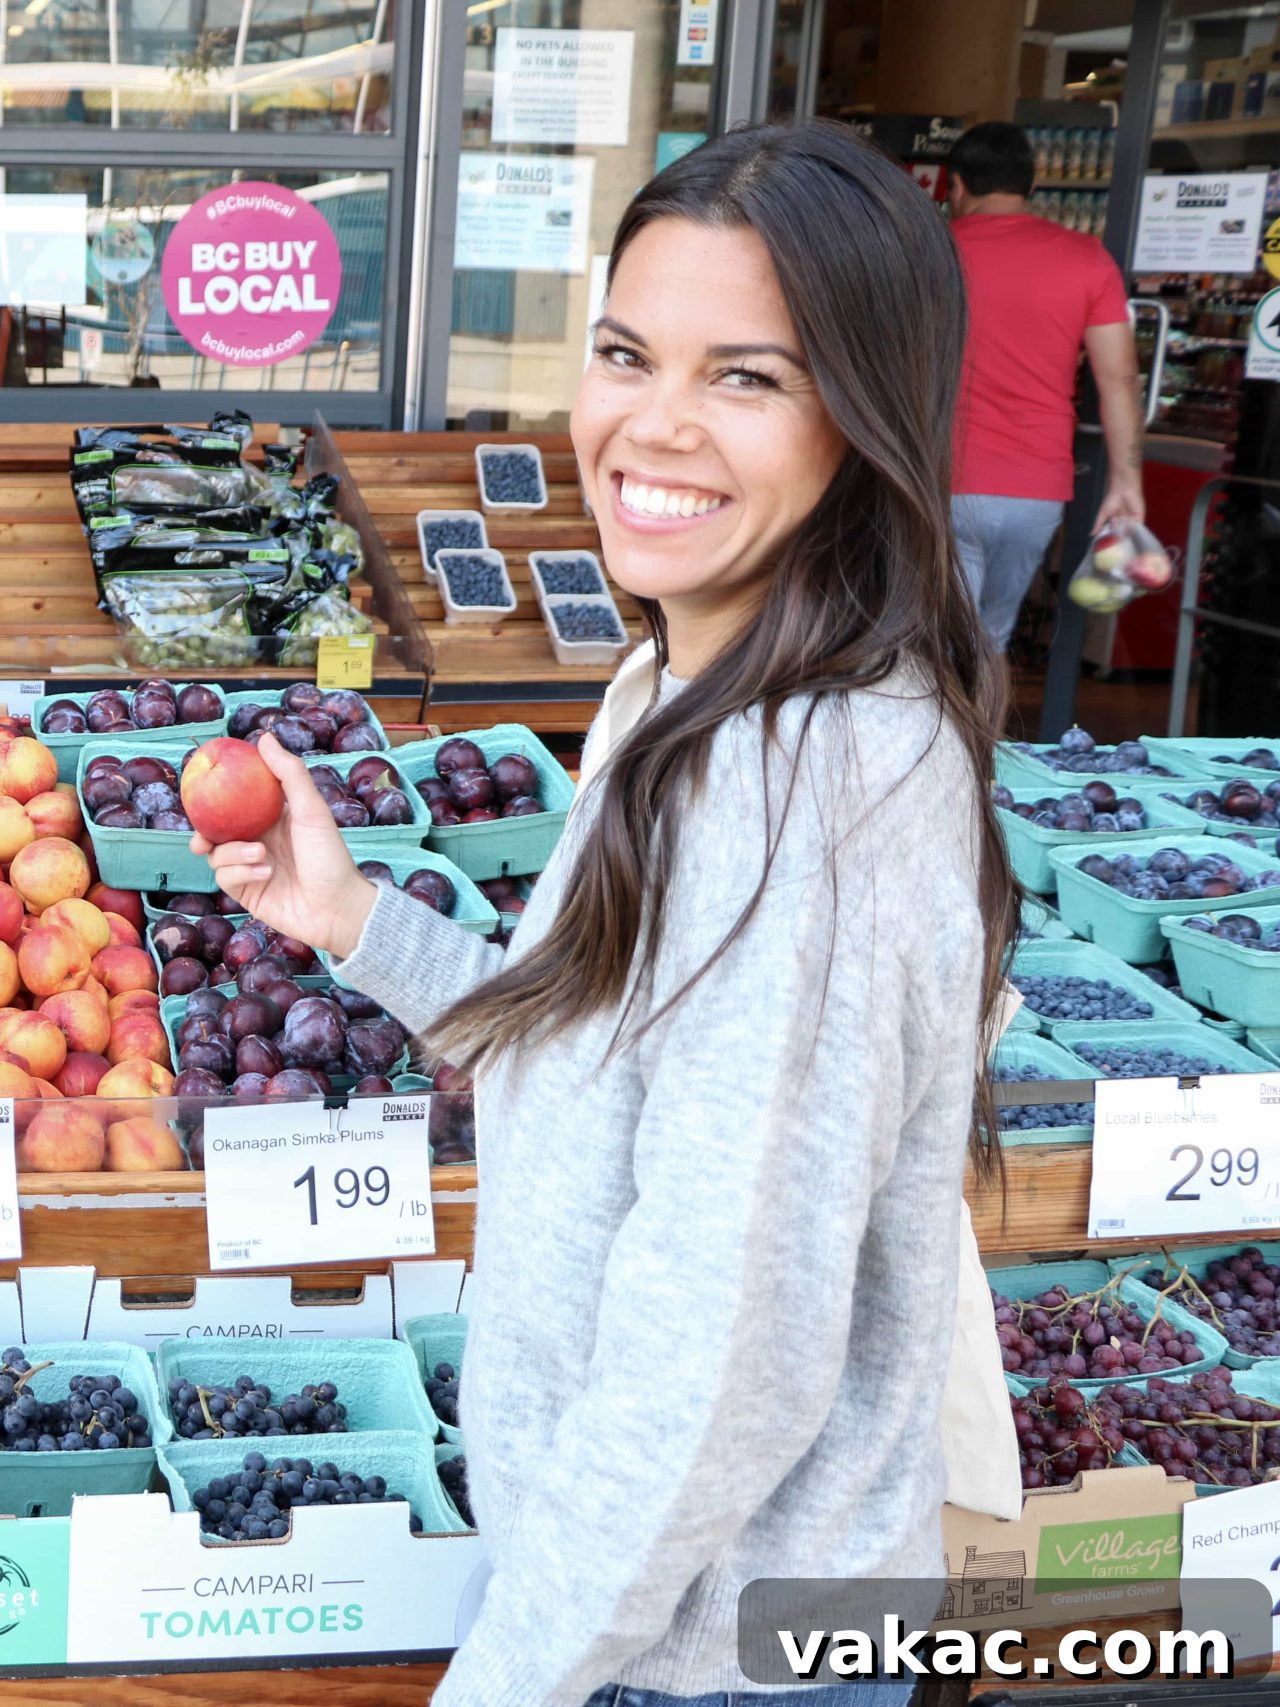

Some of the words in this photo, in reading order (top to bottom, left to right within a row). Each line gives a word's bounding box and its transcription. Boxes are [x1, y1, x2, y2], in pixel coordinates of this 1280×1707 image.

[516, 40, 533, 50] NO
[535, 40, 560, 50] PETS
[563, 41, 615, 52] ALLOWED
[520, 56, 532, 66] IN
[536, 56, 554, 67] THE
[558, 57, 608, 68] BUILDING
[206, 194, 296, 220] #BCbuylocal
[191, 242, 240, 272] BC
[244, 240, 318, 270] BUY
[178, 274, 330, 315] LOCAL
[201, 329, 304, 361] bcbuylocal.com
[1105, 1112, 1140, 1125] Local
[1144, 1111, 1218, 1124] Blueberries
[212, 1136, 287, 1152] Okanagan
[291, 1132, 336, 1146] Simka
[340, 1129, 384, 1142] Plums
[186, 1324, 283, 1338] CAMPARI
[1056, 1530, 1181, 1571] Village
[1192, 1530, 1222, 1549] Red
[193, 1573, 313, 1597] CAMPARI
[1051, 1589, 1123, 1606] Greenhouse
[1126, 1584, 1164, 1598] Grown
[140, 1603, 364, 1639] TOMATOES
